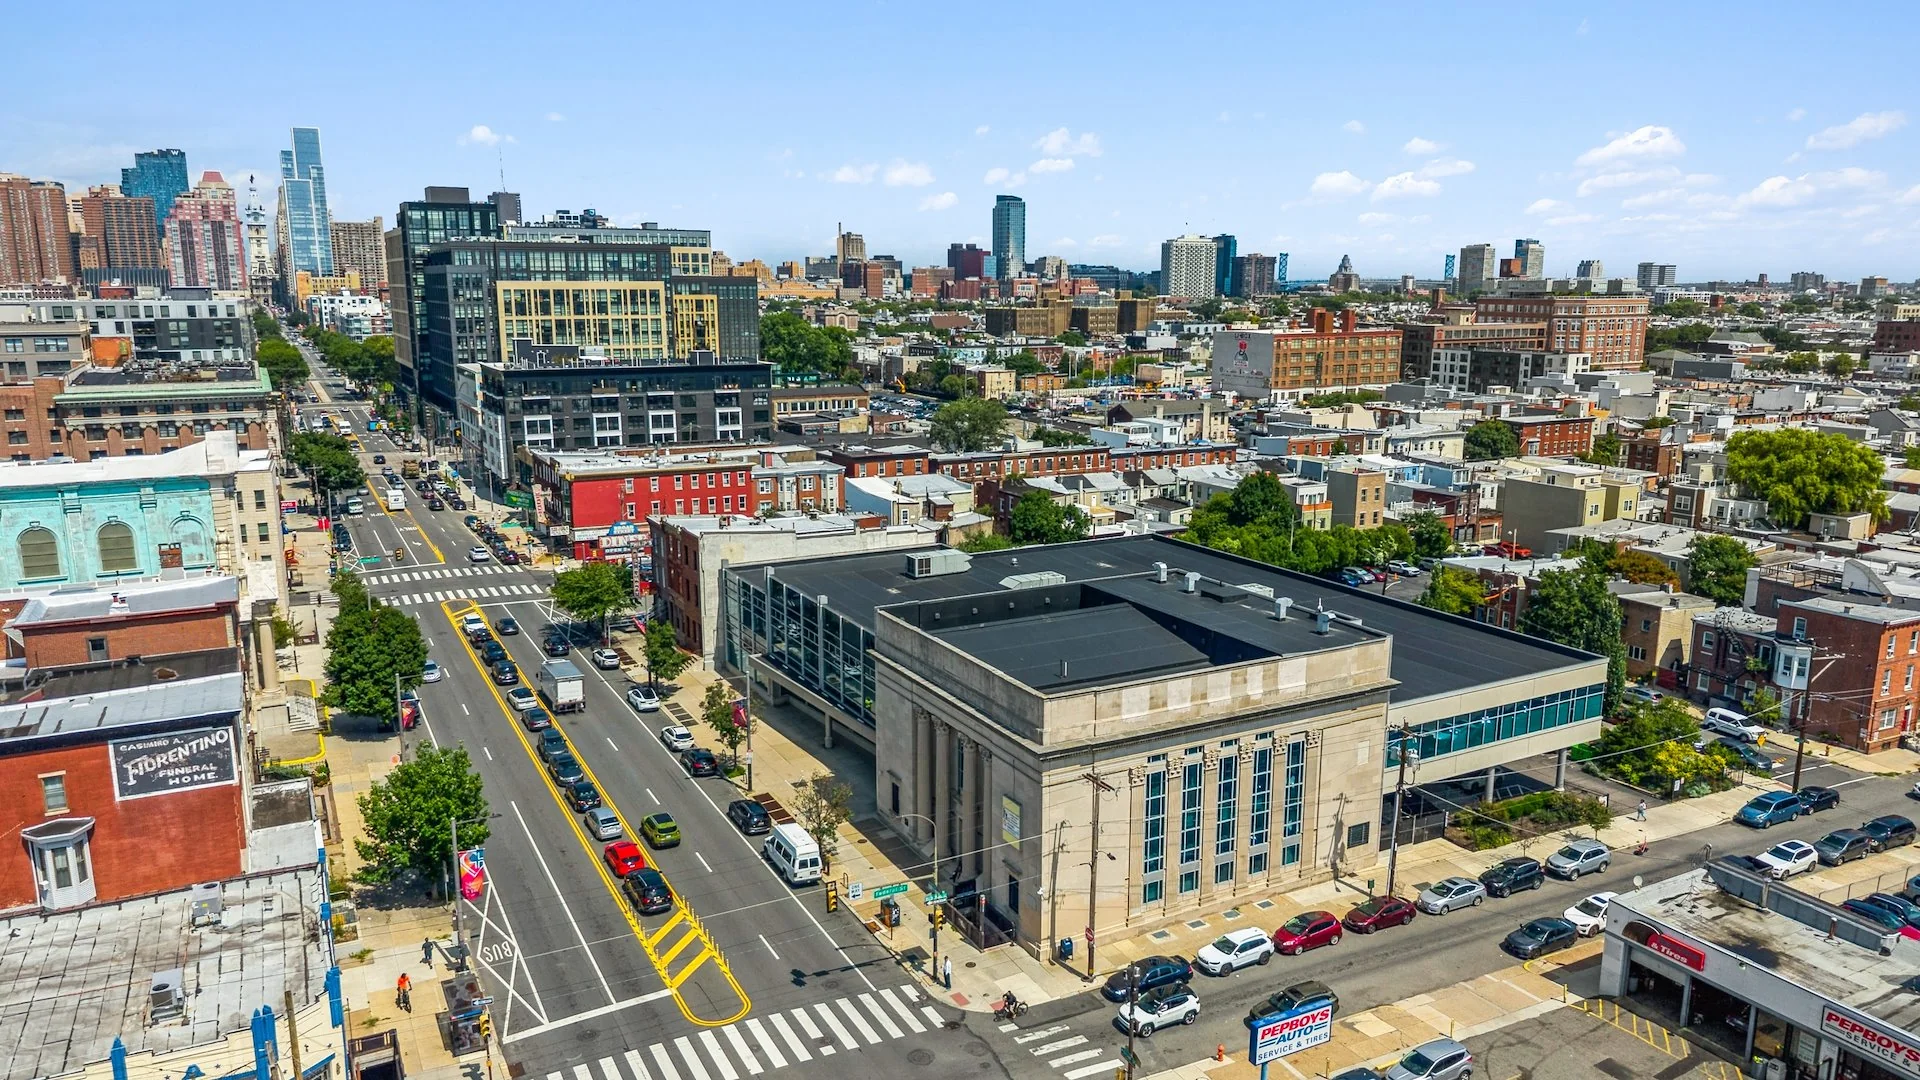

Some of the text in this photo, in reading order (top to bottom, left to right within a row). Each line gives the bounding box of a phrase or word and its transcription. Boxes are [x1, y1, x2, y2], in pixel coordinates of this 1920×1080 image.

[120, 737, 184, 751] CASIMIRO A.
[122, 729, 229, 786] FIORENTINO
[158, 762, 218, 778] FUNERAL
[482, 940, 513, 963] BUS
[1651, 942, 1688, 964] & Tires
[1260, 1009, 1330, 1040] PEPBOYS
[1275, 1025, 1314, 1045] AUTO
[1825, 1012, 1920, 1062] PEPBOYS
[1258, 1043, 1293, 1061] SERVICE
[1305, 1032, 1328, 1045] TIRES
[1845, 1031, 1911, 1067] SERVICE &
